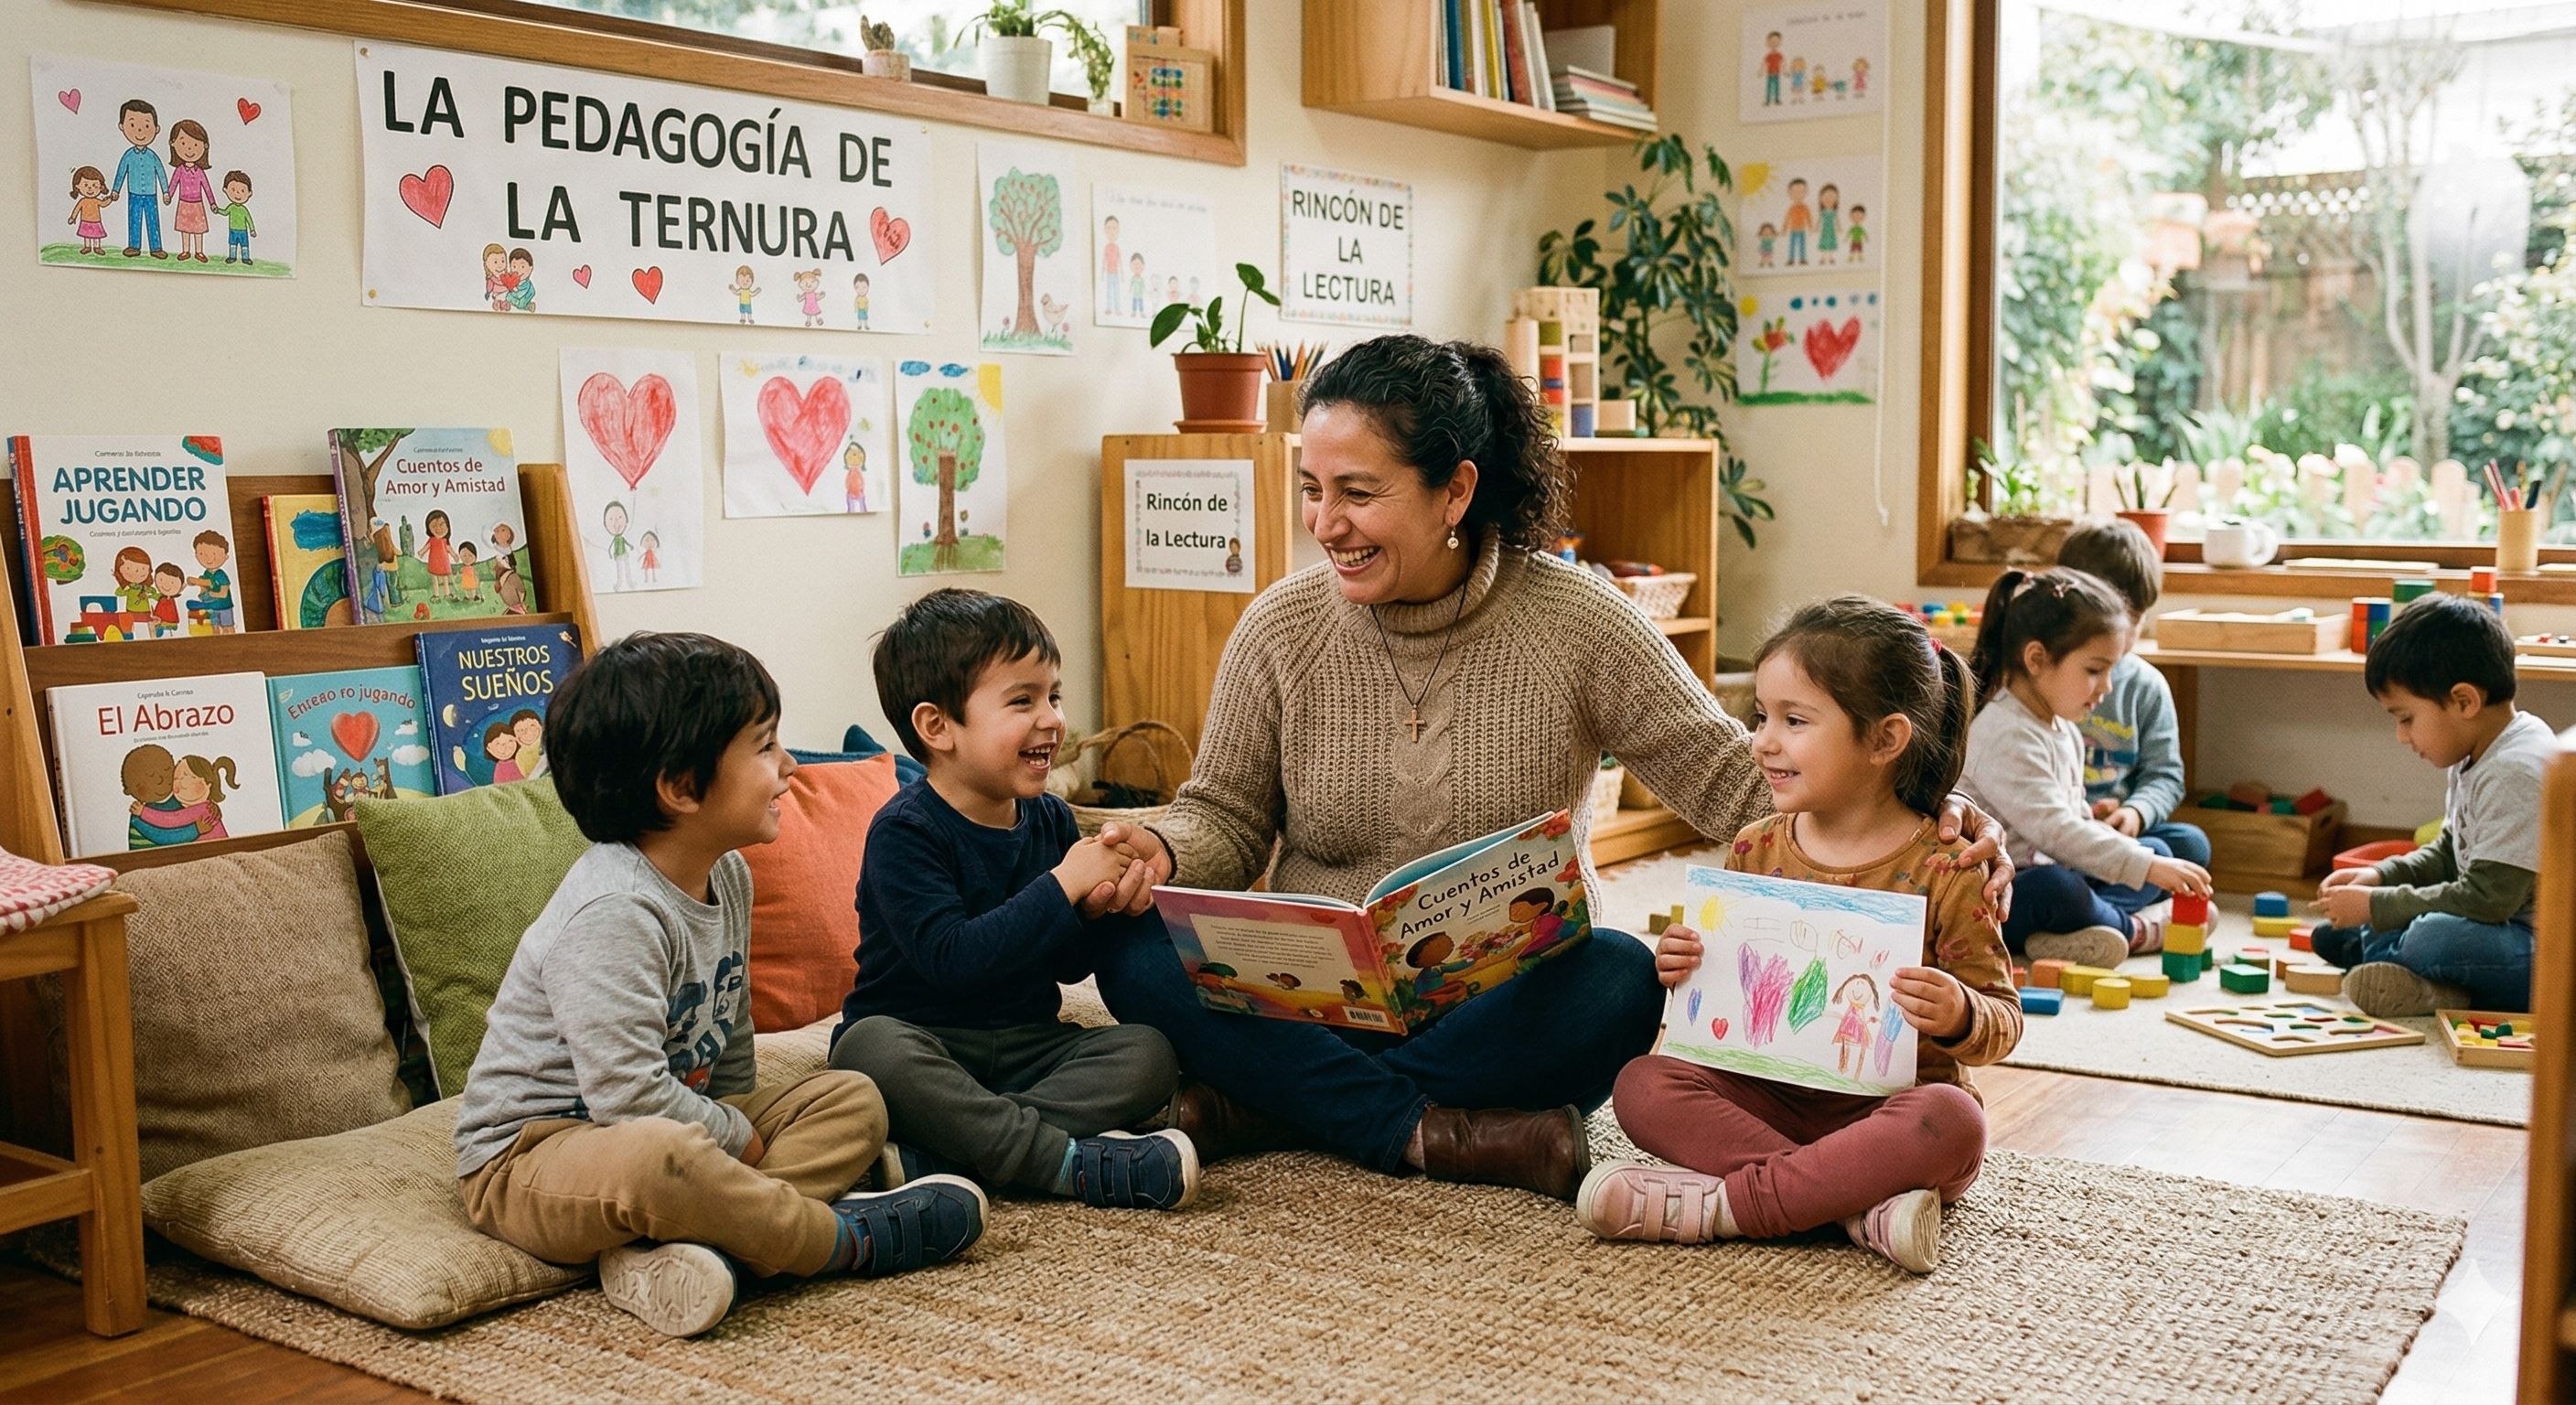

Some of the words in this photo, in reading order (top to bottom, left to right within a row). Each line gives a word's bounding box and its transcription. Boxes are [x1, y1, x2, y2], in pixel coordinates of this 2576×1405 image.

[383, 70, 465, 138] LA
[504, 85, 812, 178] PEDAGOGÍA
[839, 133, 893, 188] DE
[507, 182, 582, 243] LA
[619, 189, 854, 263] TERNURA
[1293, 188, 1371, 226] RINCÓN
[1379, 203, 1404, 231] DE
[1338, 237, 1363, 264] LA
[1303, 272, 1396, 306] LECTURA
[52, 467, 207, 493] APRENDER
[396, 458, 460, 474] Cuentos
[465, 457, 483, 472] de
[385, 479, 428, 495] Amor
[432, 482, 440, 498] y
[445, 477, 506, 493] Amistad
[1146, 492, 1202, 511] Rincón
[1208, 494, 1228, 511] de
[59, 496, 207, 525] JUGANDO
[1146, 529, 1159, 546] la
[1165, 531, 1226, 549] Lectura
[458, 645, 551, 670] NUESTROS
[358, 683, 416, 709] jugando
[461, 667, 554, 702] SUEÑOS
[98, 705, 123, 735] El
[133, 702, 235, 733] Abrazo
[1401, 906, 1454, 939] Amor
[1459, 898, 1472, 917] y
[1478, 850, 1560, 905] Amistad
[1418, 866, 1500, 910] Cuentos
[1508, 852, 1531, 870] de
